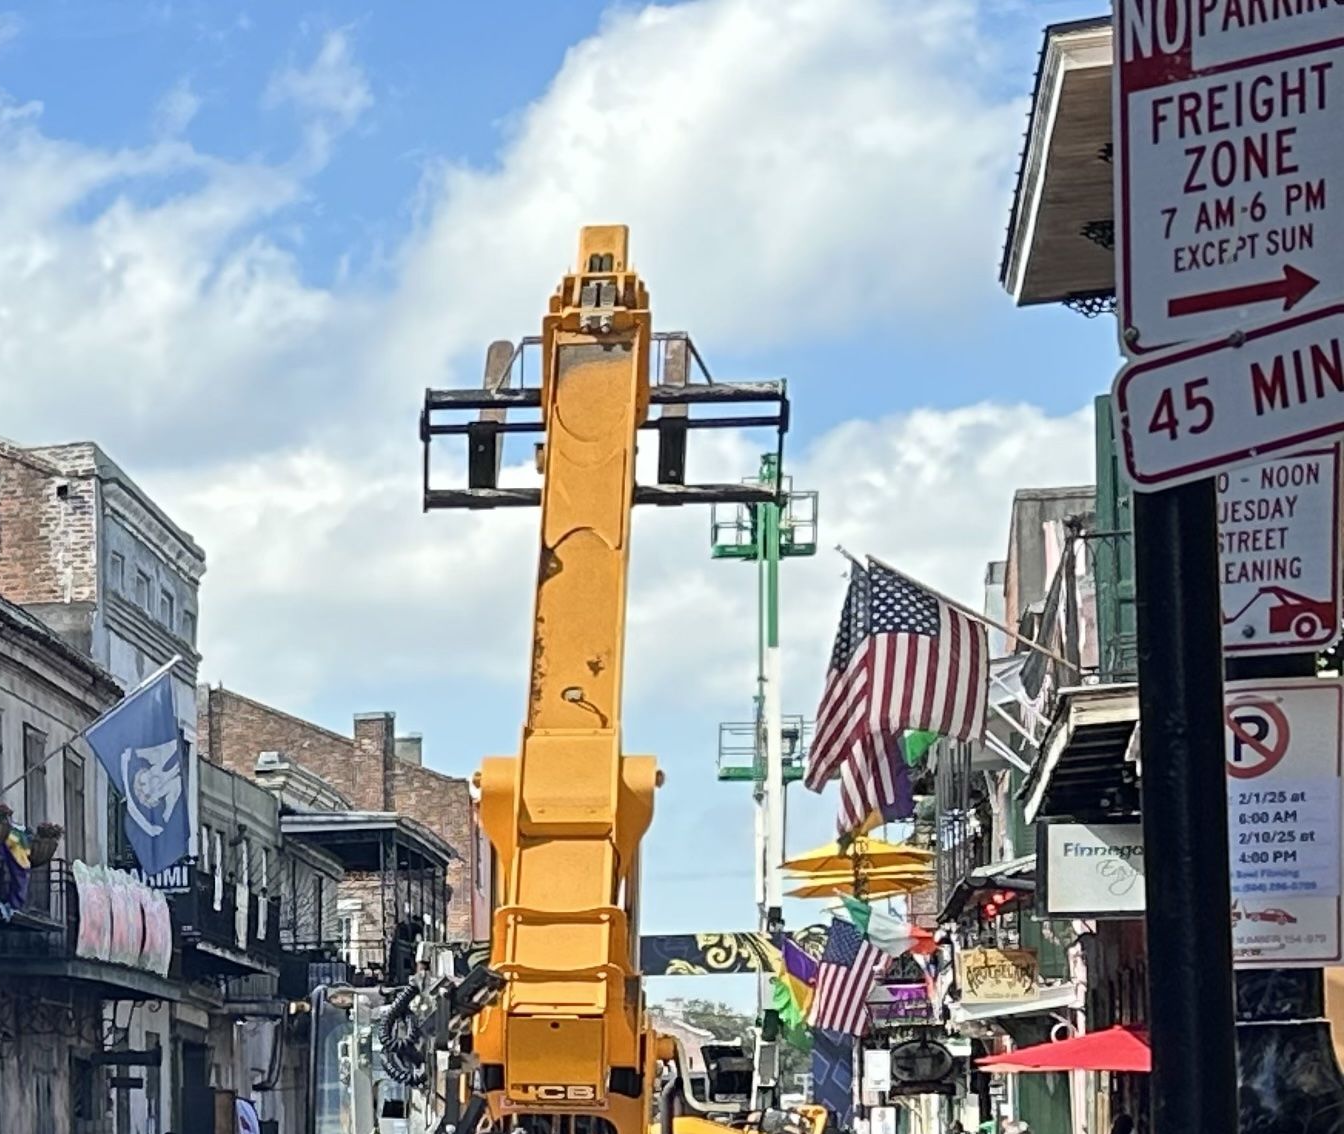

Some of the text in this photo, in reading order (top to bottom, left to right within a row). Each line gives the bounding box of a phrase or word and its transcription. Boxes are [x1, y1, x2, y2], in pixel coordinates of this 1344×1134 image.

[1125, 0, 1187, 62] NO
[1152, 62, 1333, 145] FREIGHT
[1184, 127, 1299, 194] ZONE
[1161, 207, 1177, 239] 7
[1285, 178, 1325, 216] PM
[1174, 223, 1314, 273] EXCEPT SUN
[1148, 338, 1344, 440] 45 MIN
[1260, 462, 1320, 489] NOON
[1217, 495, 1298, 524] UESDAY
[1224, 557, 1302, 584] EANING
[1273, 810, 1297, 823] AM
[1063, 842, 1144, 859] Finnega
[1272, 850, 1297, 863] PM
[513, 1085, 596, 1100] JCB
